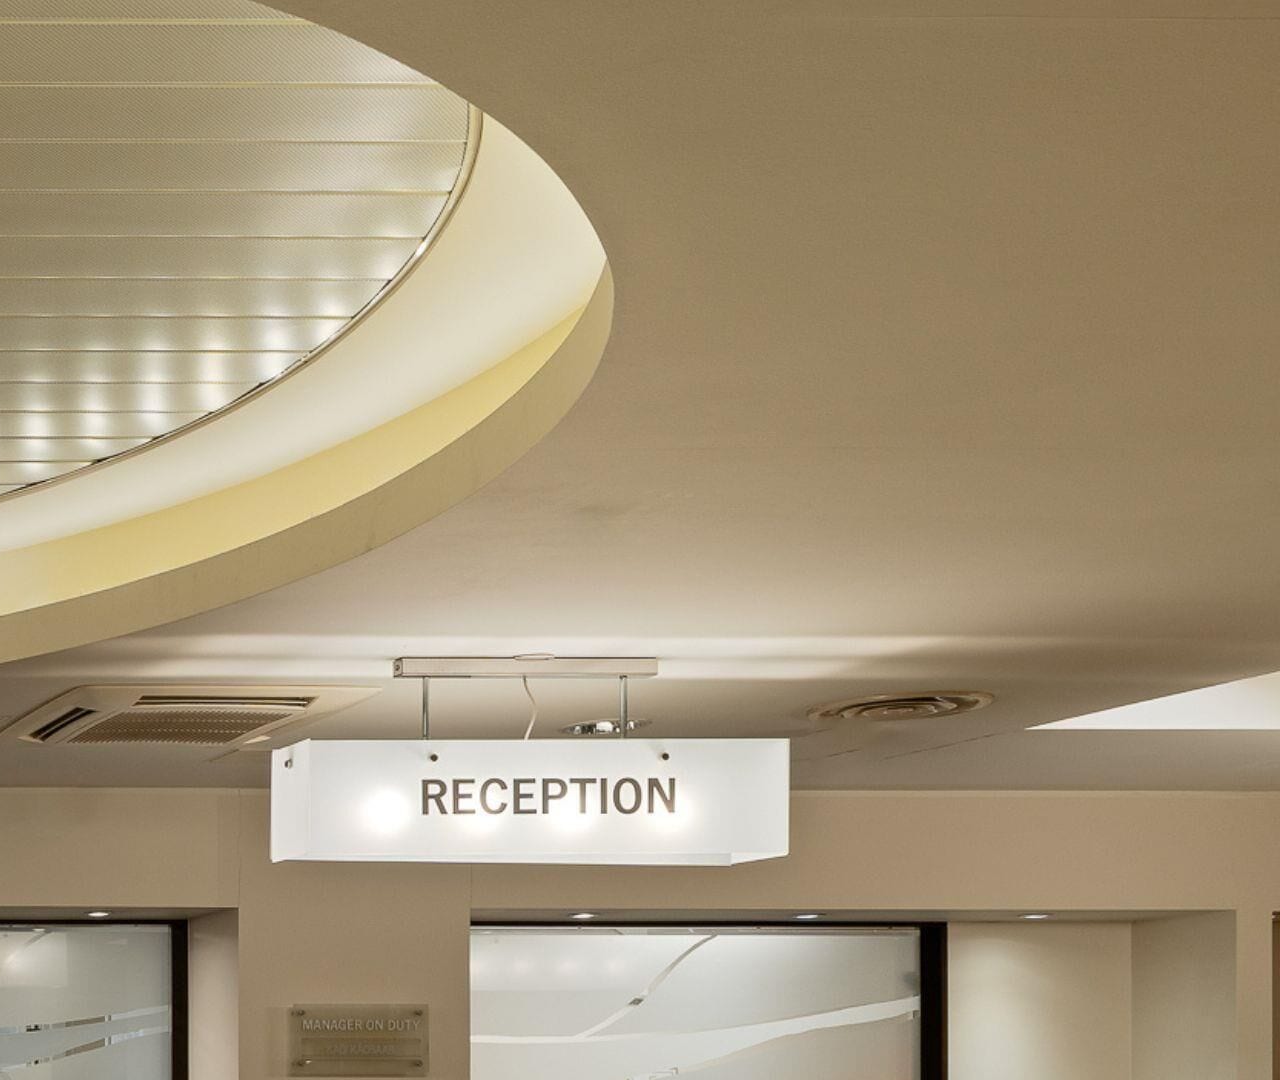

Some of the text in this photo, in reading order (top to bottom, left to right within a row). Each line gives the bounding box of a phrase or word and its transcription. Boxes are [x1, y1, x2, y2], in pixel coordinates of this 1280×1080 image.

[421, 777, 676, 815] RECEPTION
[302, 1019, 420, 1031] MANAGER ON DUTY
